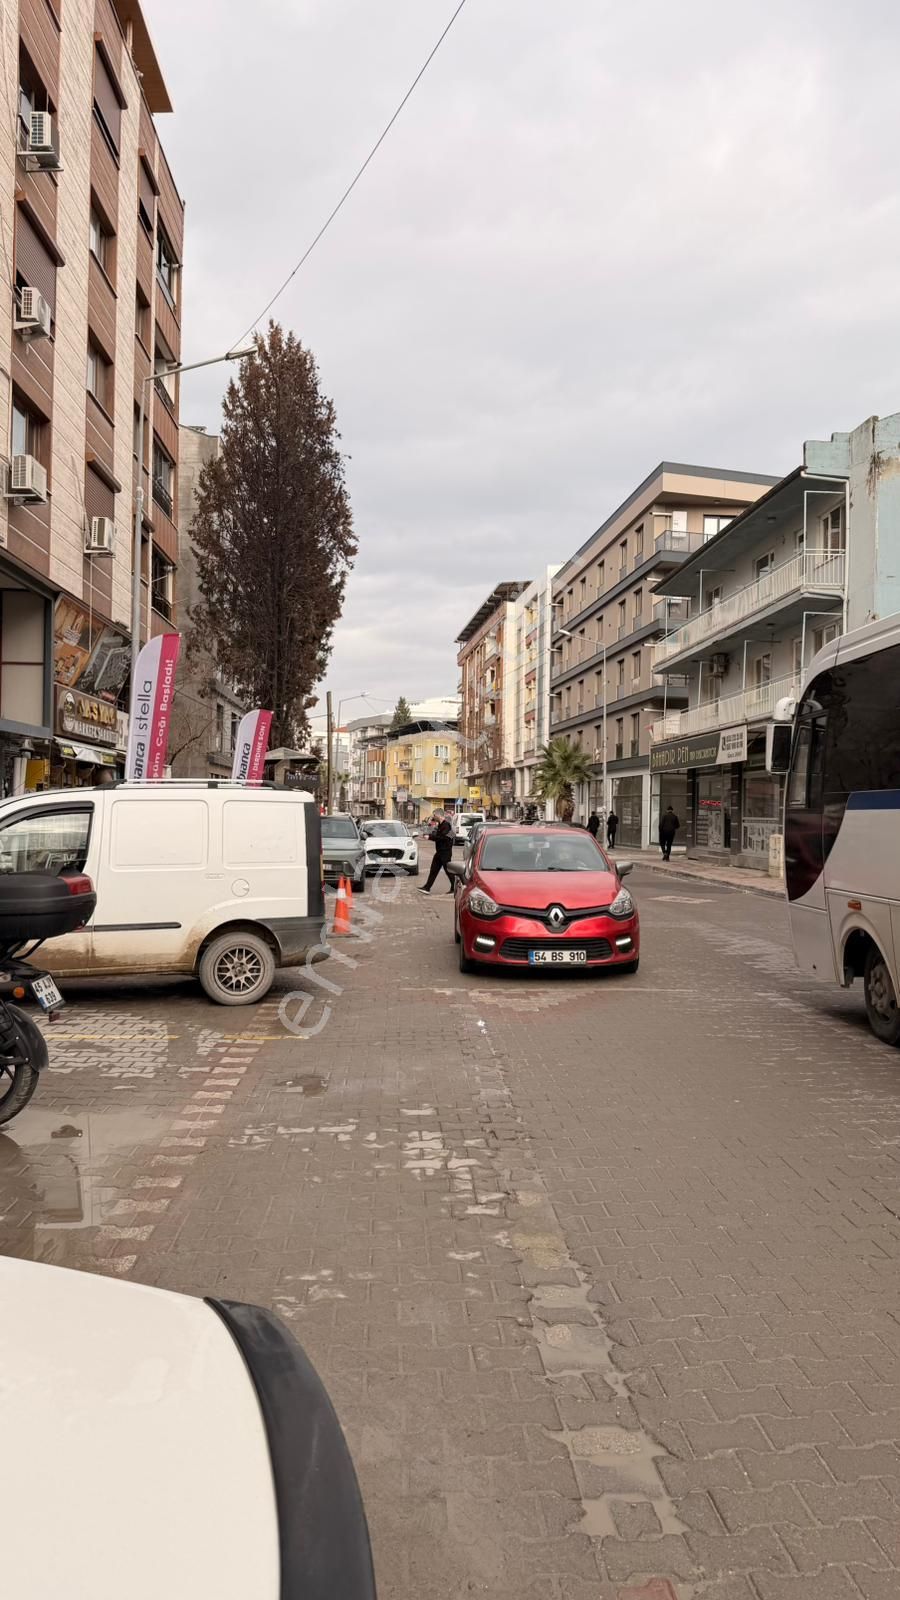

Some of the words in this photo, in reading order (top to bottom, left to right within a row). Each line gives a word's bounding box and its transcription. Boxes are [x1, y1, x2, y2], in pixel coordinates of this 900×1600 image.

[136, 680, 152, 730] stella
[534, 952, 547, 961] 54
[551, 952, 564, 961] BS
[569, 952, 586, 961] 910
[34, 982, 43, 993] 45
[45, 991, 57, 1004] 639
